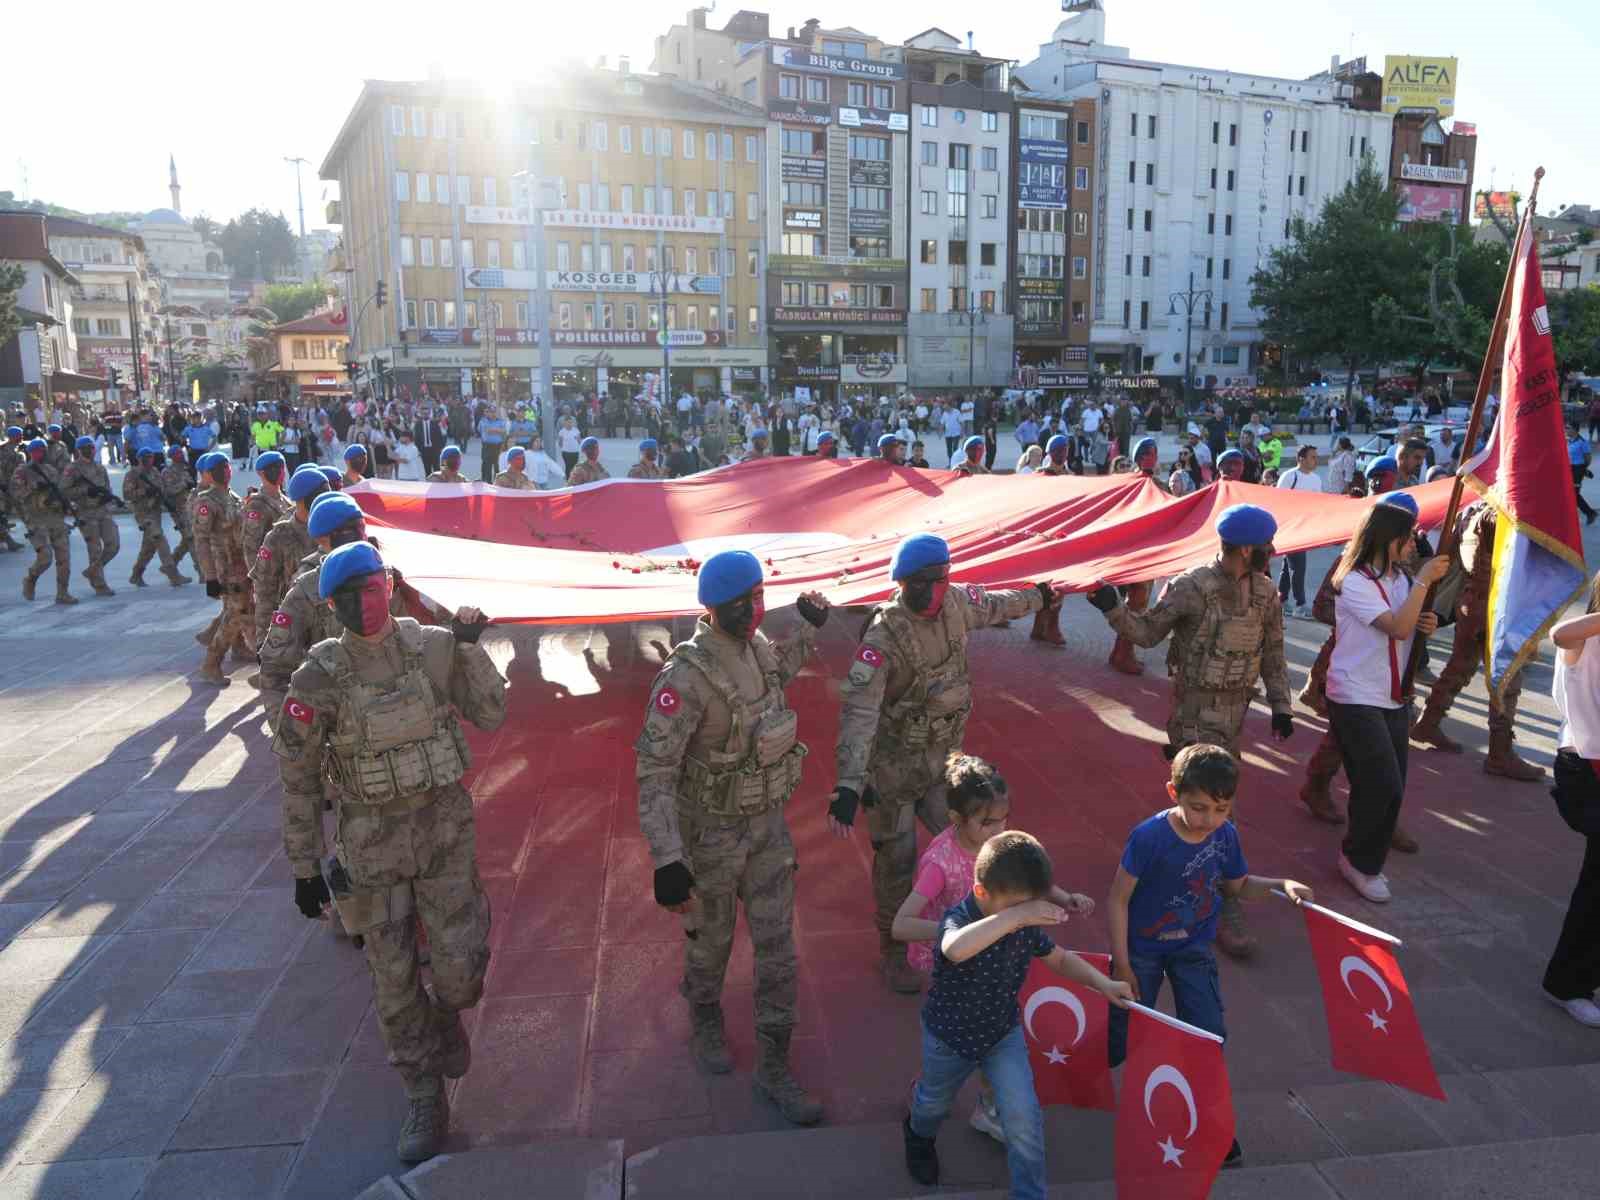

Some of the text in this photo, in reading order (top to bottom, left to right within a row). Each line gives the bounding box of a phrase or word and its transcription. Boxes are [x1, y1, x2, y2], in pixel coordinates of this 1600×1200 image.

[808, 54, 894, 77] Bilge Group
[558, 271, 637, 284] KOSGEB
